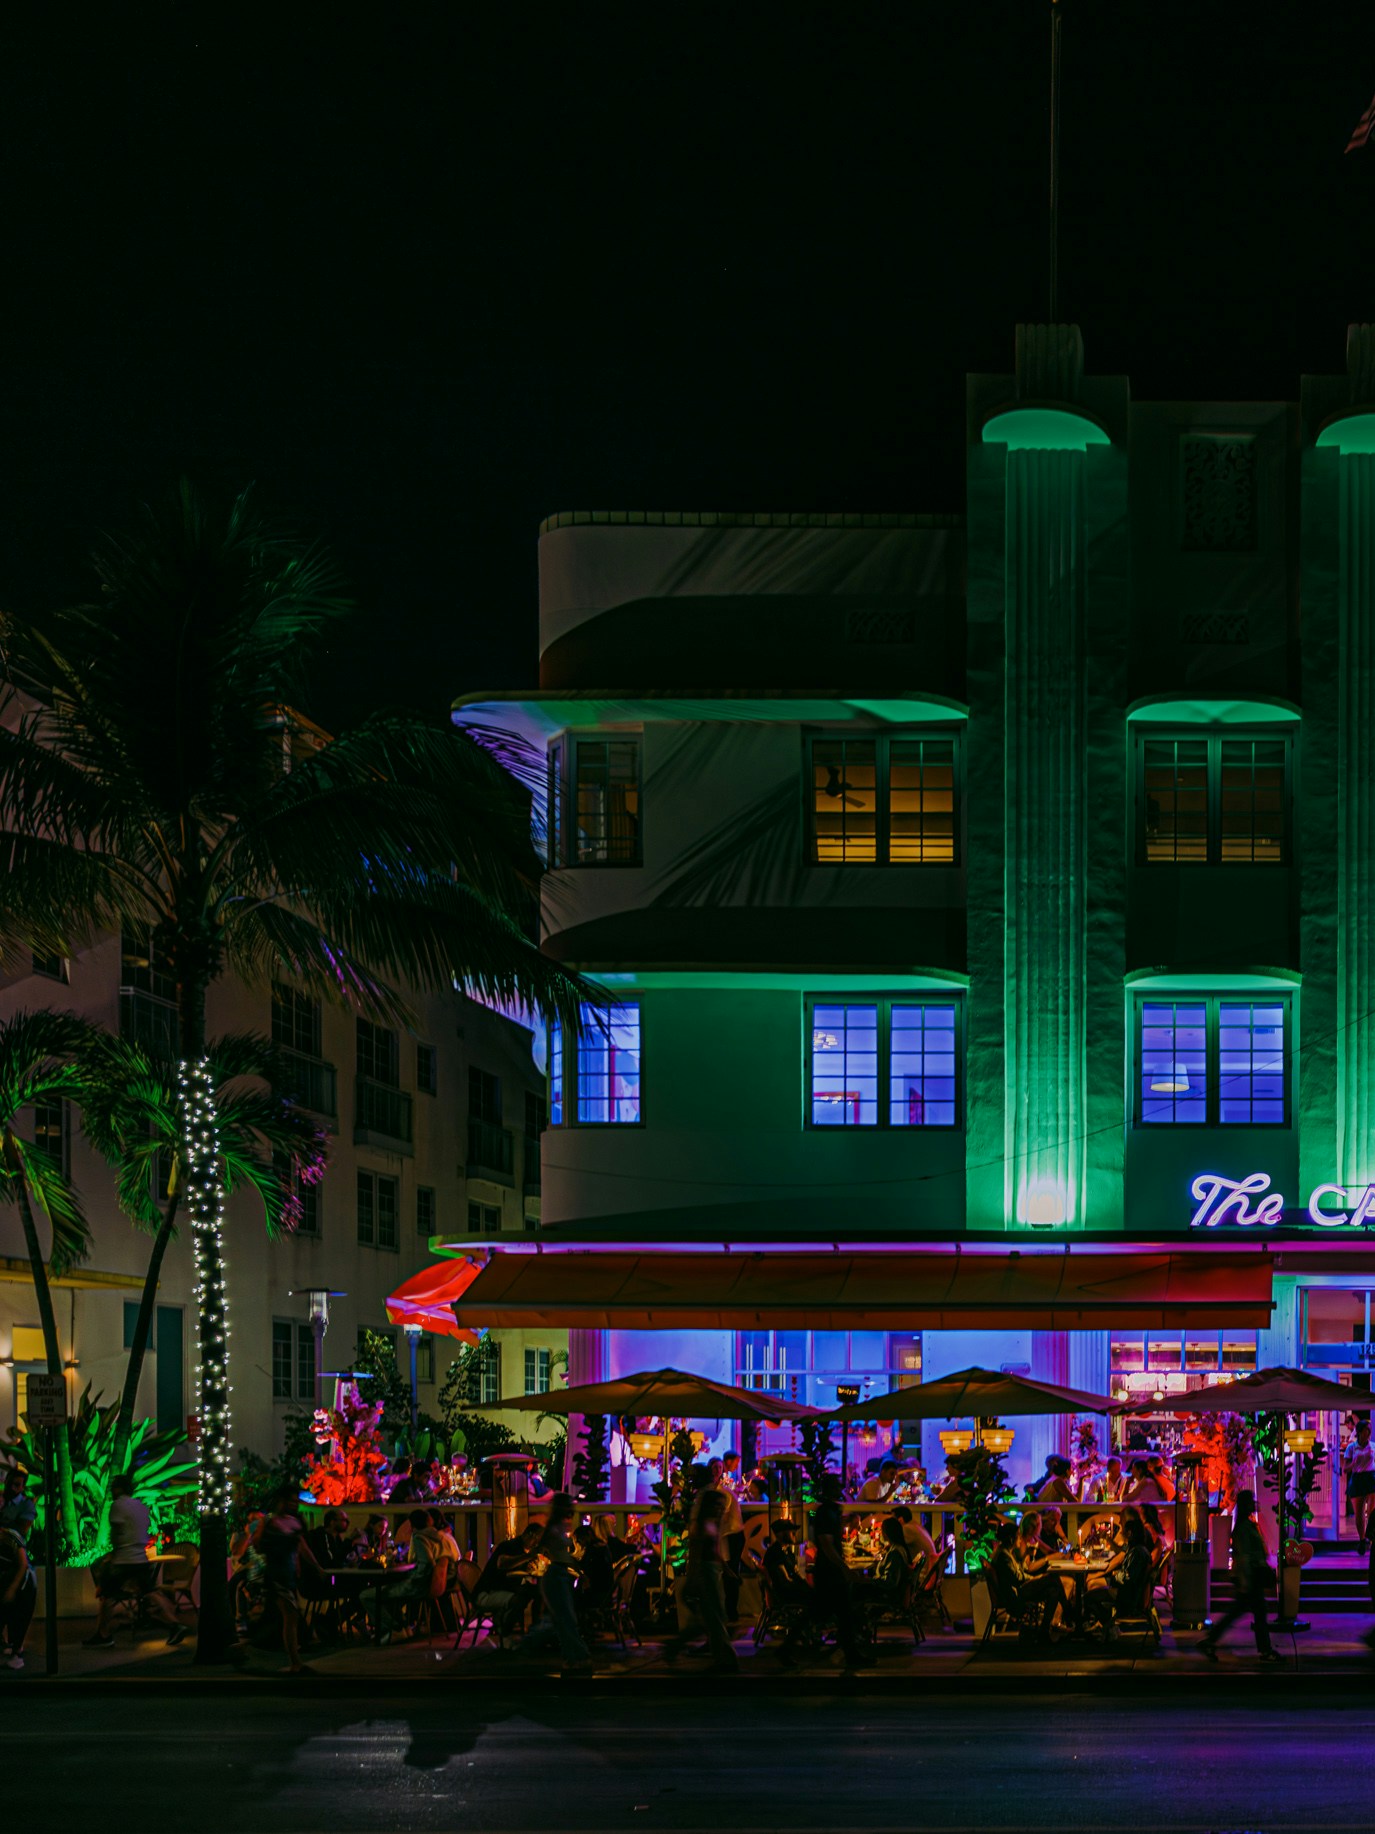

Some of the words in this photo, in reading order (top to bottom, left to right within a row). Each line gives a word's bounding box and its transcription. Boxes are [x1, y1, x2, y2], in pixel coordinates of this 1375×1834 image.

[1191, 1173, 1284, 1227] The
[39, 1376, 54, 1386] NO
[30, 1388, 63, 1397] PARKING
